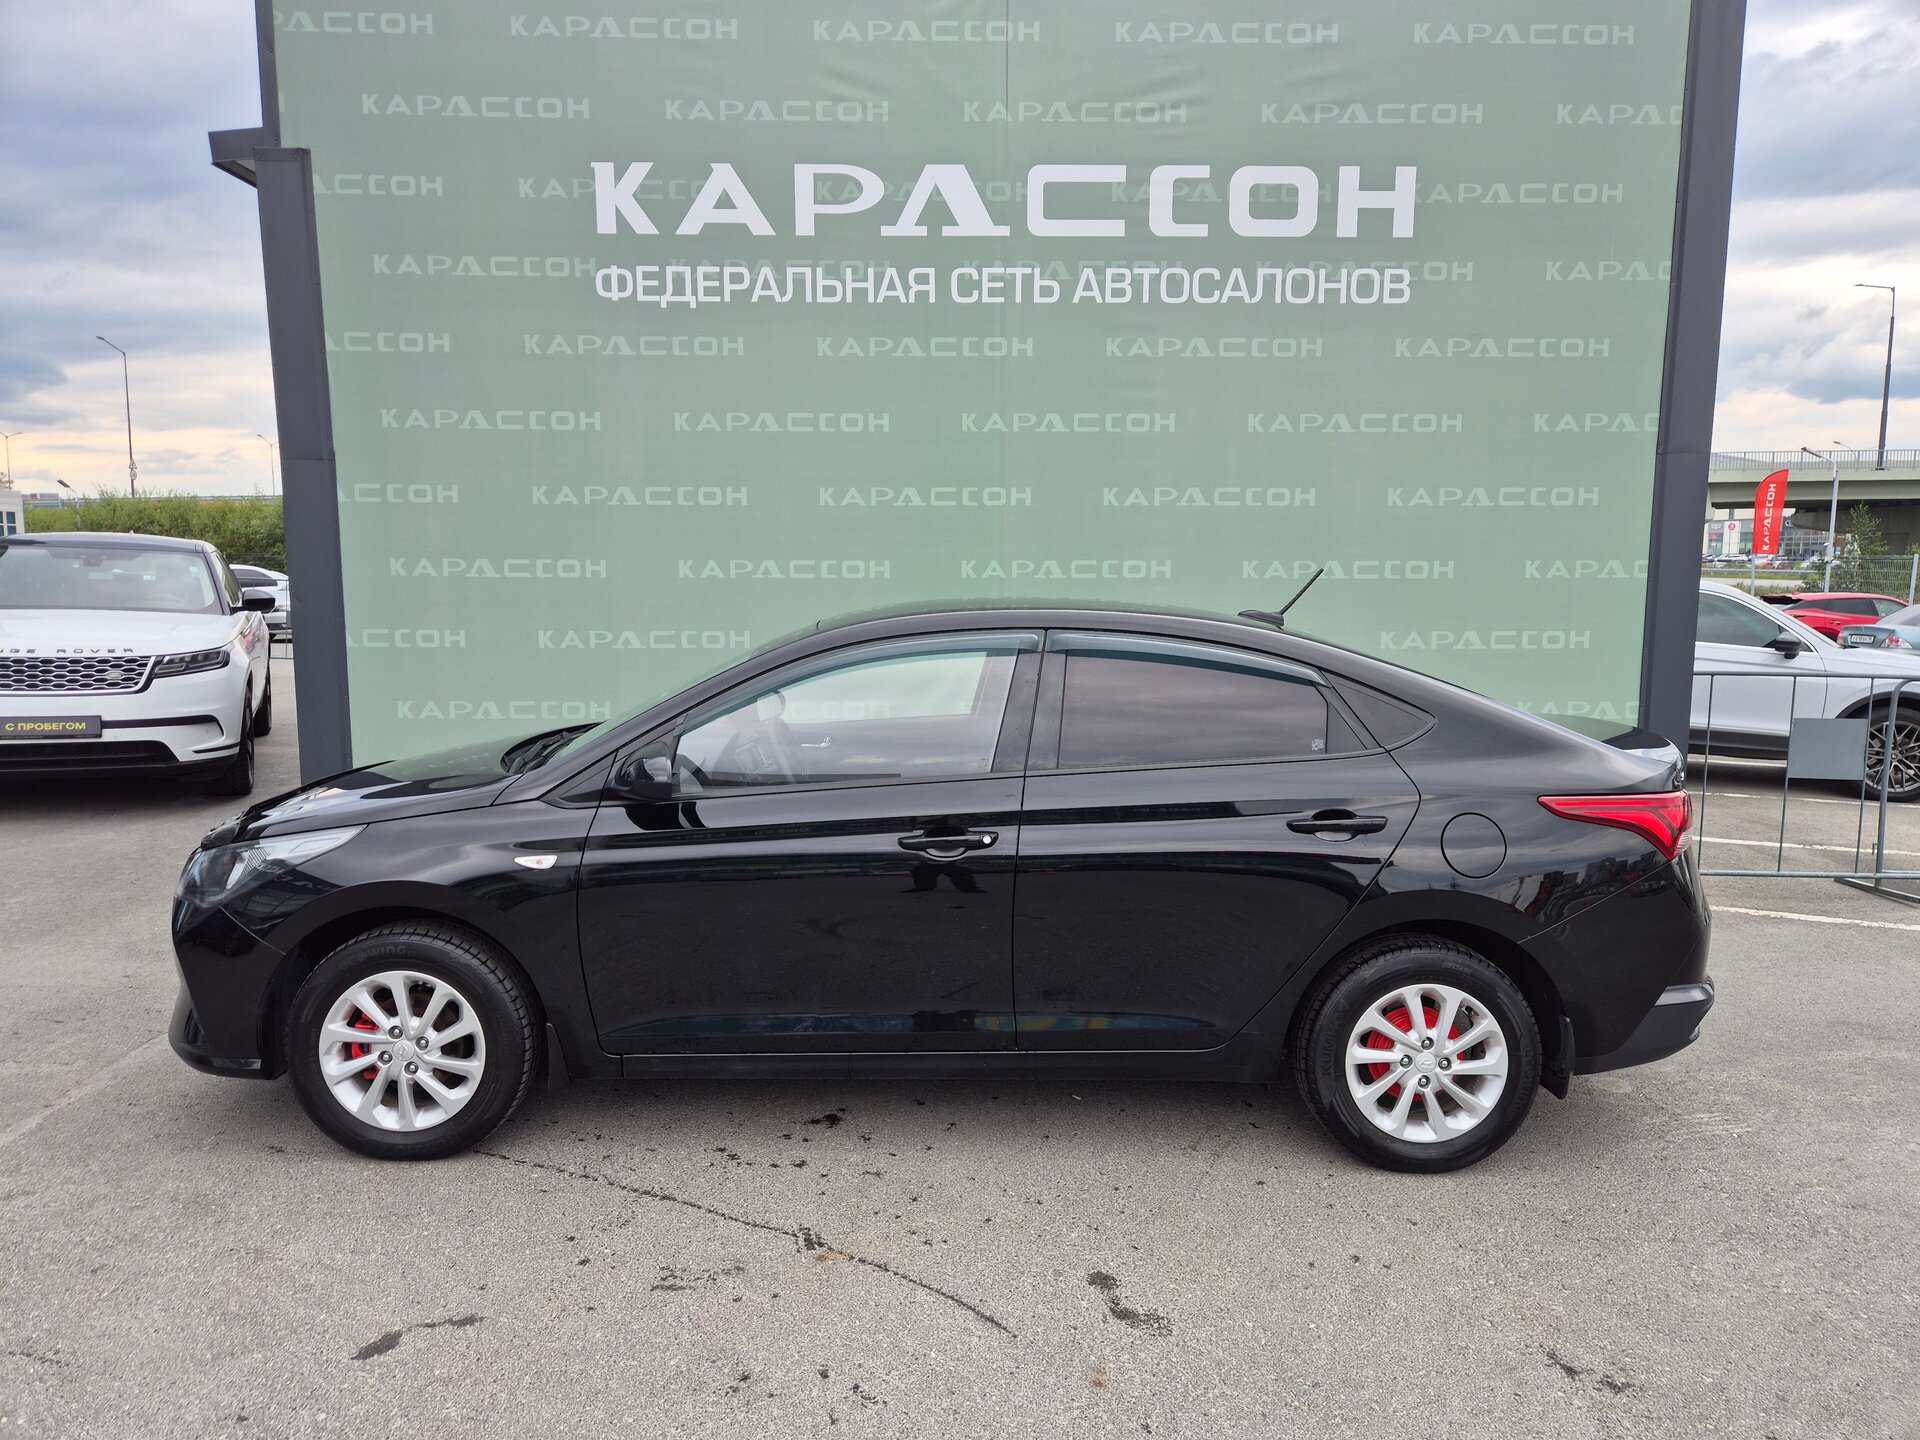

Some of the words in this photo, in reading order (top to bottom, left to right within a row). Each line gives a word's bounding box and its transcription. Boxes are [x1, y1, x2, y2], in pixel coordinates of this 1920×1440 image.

[510, 16, 740, 40] КАРАССОН
[813, 20, 1041, 43] КАРАССОН
[1115, 22, 1340, 45] КАРАССОН
[1414, 24, 1636, 46] КАРАССОН
[361, 94, 591, 120] КАРАССОН
[665, 99, 890, 123] КАРАССОН
[964, 102, 1188, 124] КАРАССОН
[1261, 104, 1484, 125] КАРАССОН
[590, 162, 1418, 238] КАРАССОН
[373, 255, 597, 278] КАРАССОН
[595, 264, 937, 308] ФЕДЕРАЛЬНАЯ
[950, 266, 1060, 304] СЕТЬ
[1072, 266, 1411, 304] АВТОСАЛОНОВ
[524, 335, 745, 357] КАРАССОН
[817, 337, 1034, 358] КАРАССОН
[1106, 337, 1323, 358] КАРАССОН
[1395, 338, 1611, 358] КАРАССОН
[381, 409, 602, 432] КАРАССОН
[674, 412, 891, 433] КАРАССОН
[962, 413, 1177, 434] КАРАССОН
[1248, 413, 1464, 434] КАРАССОН
[532, 485, 748, 507] КАРАССОН
[819, 487, 1033, 507] КАРАССОН
[1103, 488, 1317, 508] КАРАССОН
[1387, 487, 1600, 508] КАРАССОН
[1762, 484, 1777, 550] КАРАССОН
[390, 557, 608, 579] КАРАССОН
[678, 559, 891, 580] КАРАССОН
[961, 560, 1173, 580] КАРАССОН
[1242, 560, 1455, 580] КАРАССОН
[347, 628, 467, 649] ССОН
[537, 630, 752, 650] КАРАССОН
[1379, 630, 1590, 650] КАРАССОН
[398, 700, 611, 720] КАРАССОН
[5, 722, 15, 731] С
[17, 721, 87, 731] ПРОБЕГОМ
